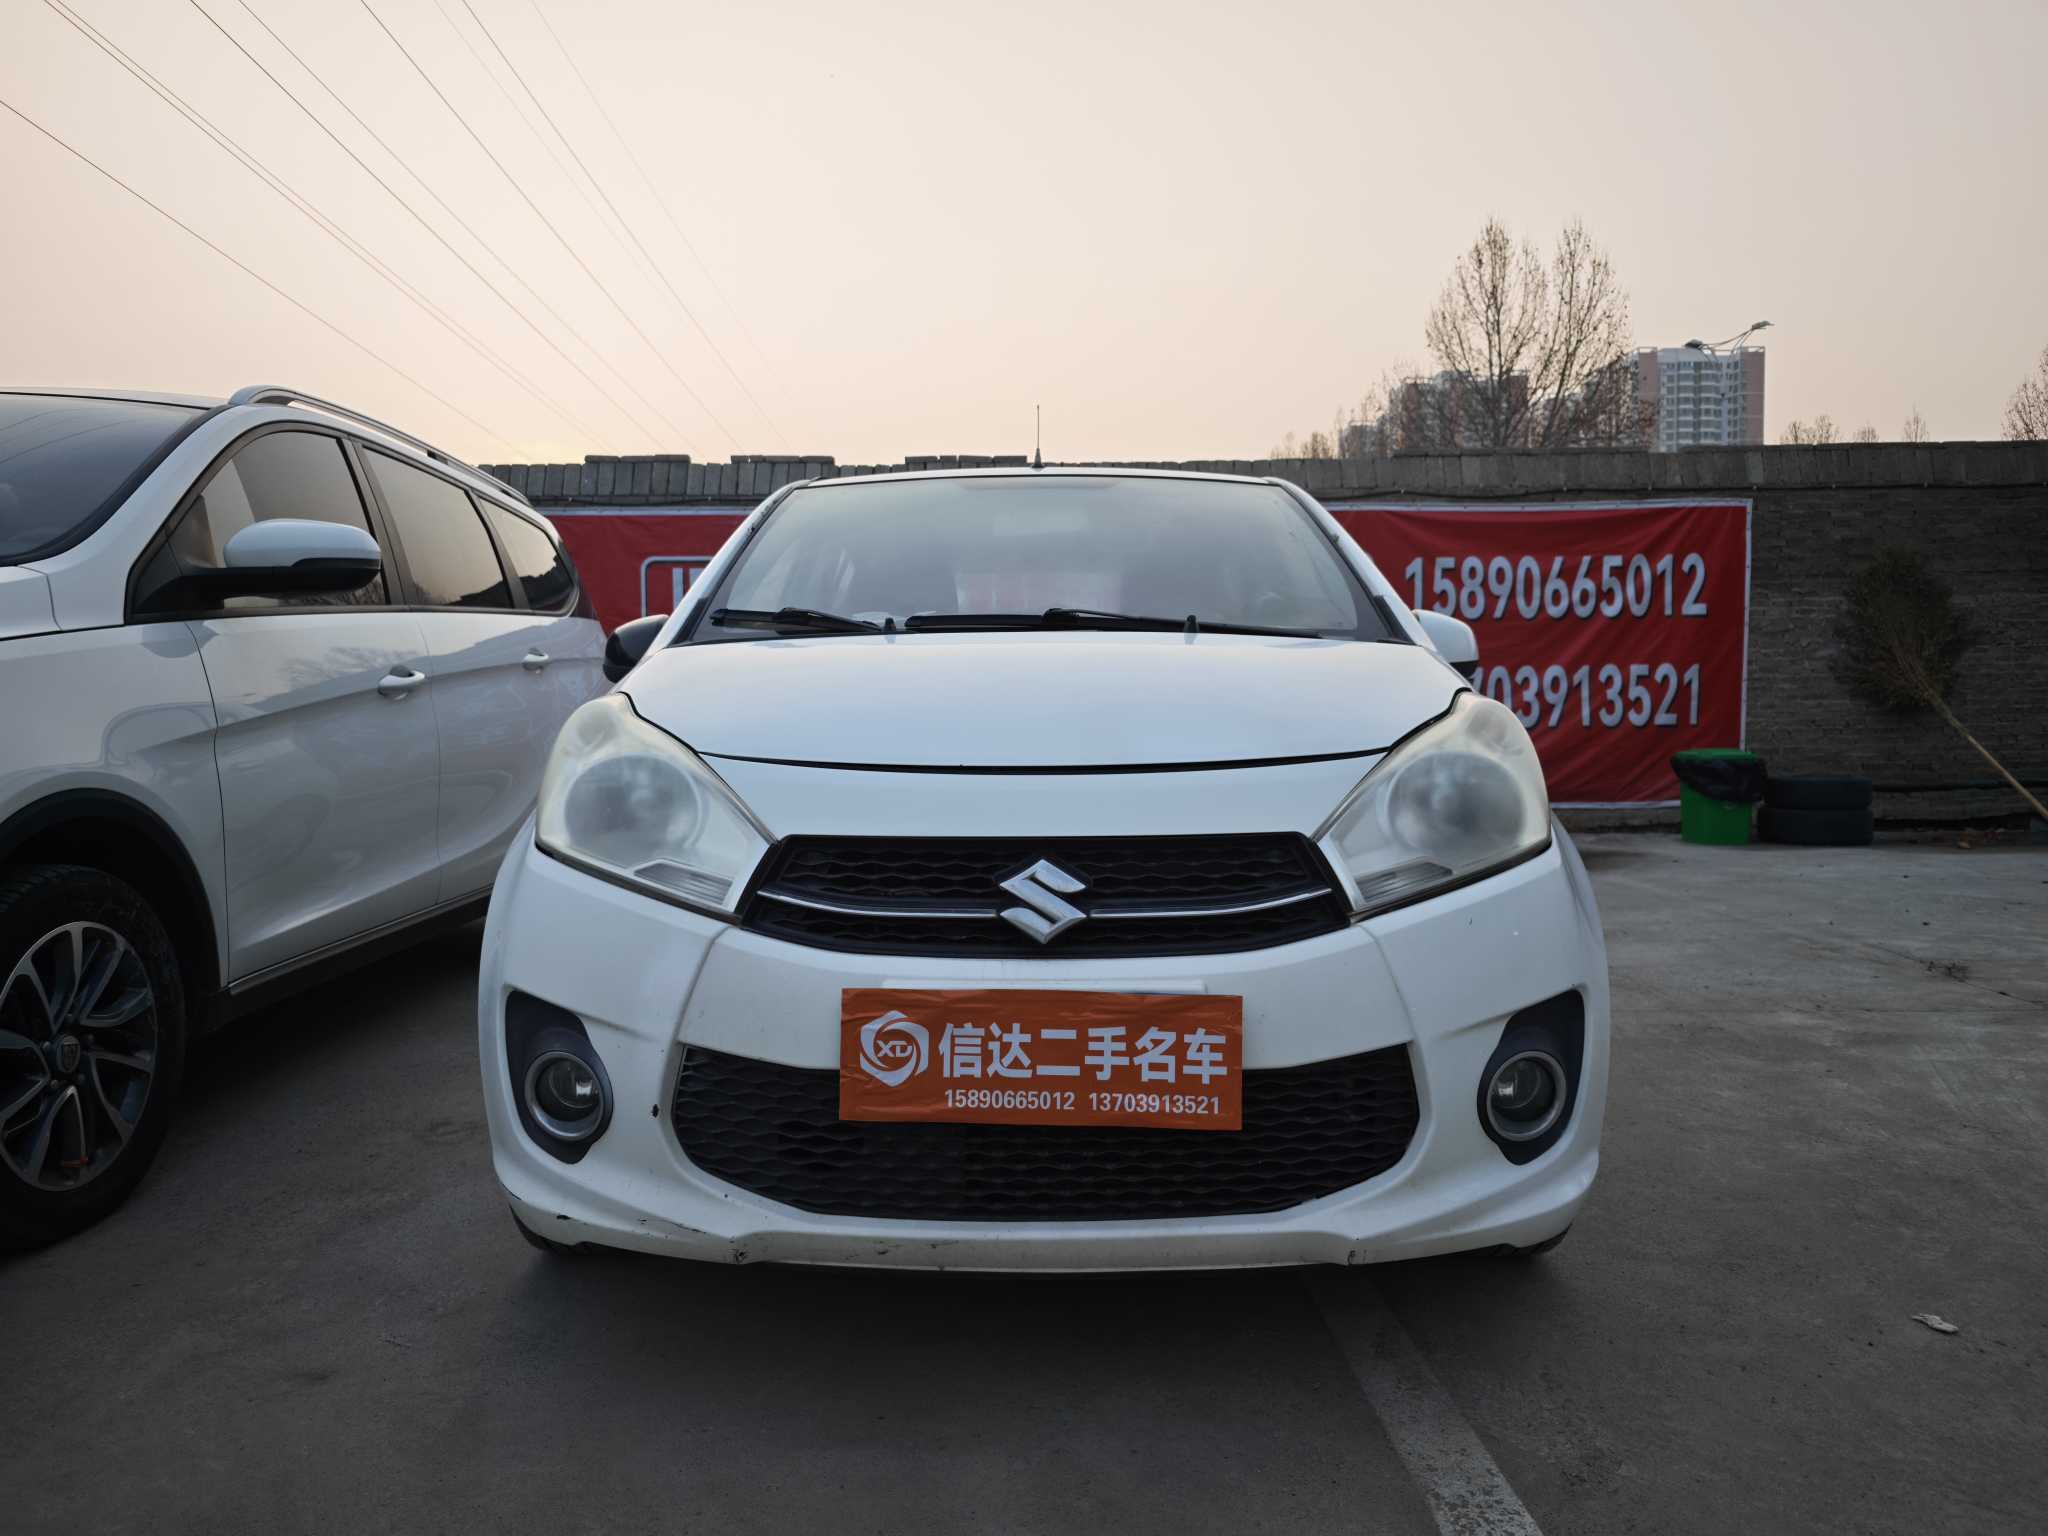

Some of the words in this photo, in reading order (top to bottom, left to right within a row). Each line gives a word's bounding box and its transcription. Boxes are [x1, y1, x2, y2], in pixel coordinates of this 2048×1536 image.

[1405, 553, 1708, 620] 15890665012
[1468, 662, 1701, 729] 03913521
[938, 1022, 1228, 1085] 信达二手名车
[945, 1088, 1075, 1111] 15890665012
[1089, 1092, 1220, 1115] 13703913521
